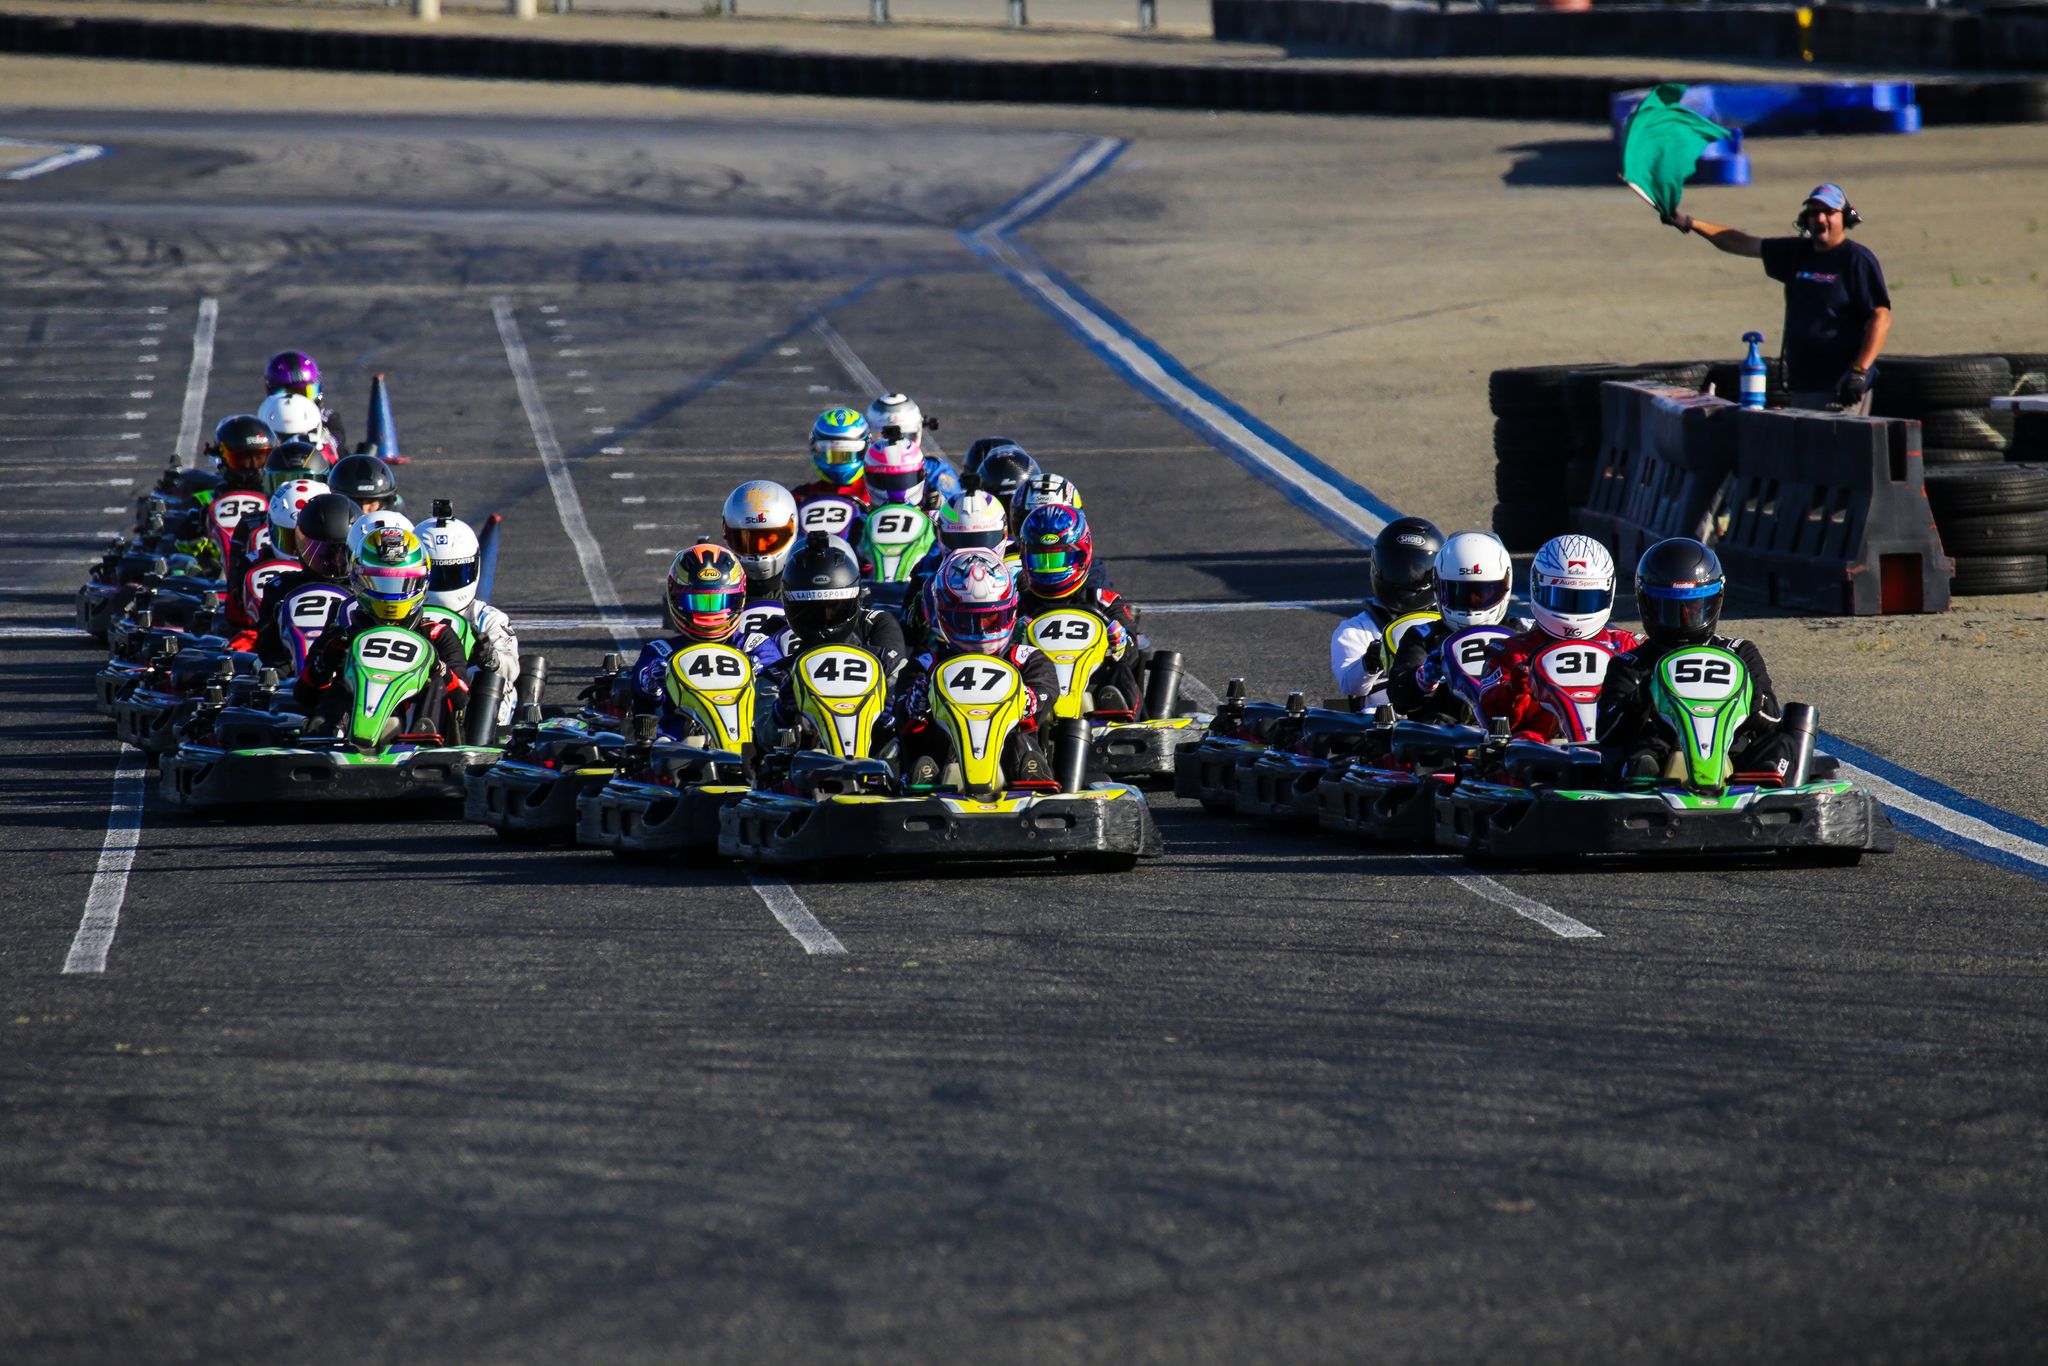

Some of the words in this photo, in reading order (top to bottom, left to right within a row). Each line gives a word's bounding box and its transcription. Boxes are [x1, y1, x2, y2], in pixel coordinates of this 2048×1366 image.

[218, 500, 261, 518] 33
[805, 507, 848, 525] 23
[877, 515, 914, 533] 51
[1400, 535, 1422, 544] SHOEI
[701, 570, 718, 578] Arai
[1559, 578, 1578, 587] Audi
[1039, 619, 1090, 640] 43
[361, 637, 418, 663] 59
[688, 654, 741, 677] 48
[813, 657, 867, 682] 42
[1555, 651, 1597, 674] 31
[1674, 658, 1731, 685] 52
[949, 666, 1007, 691] 47
